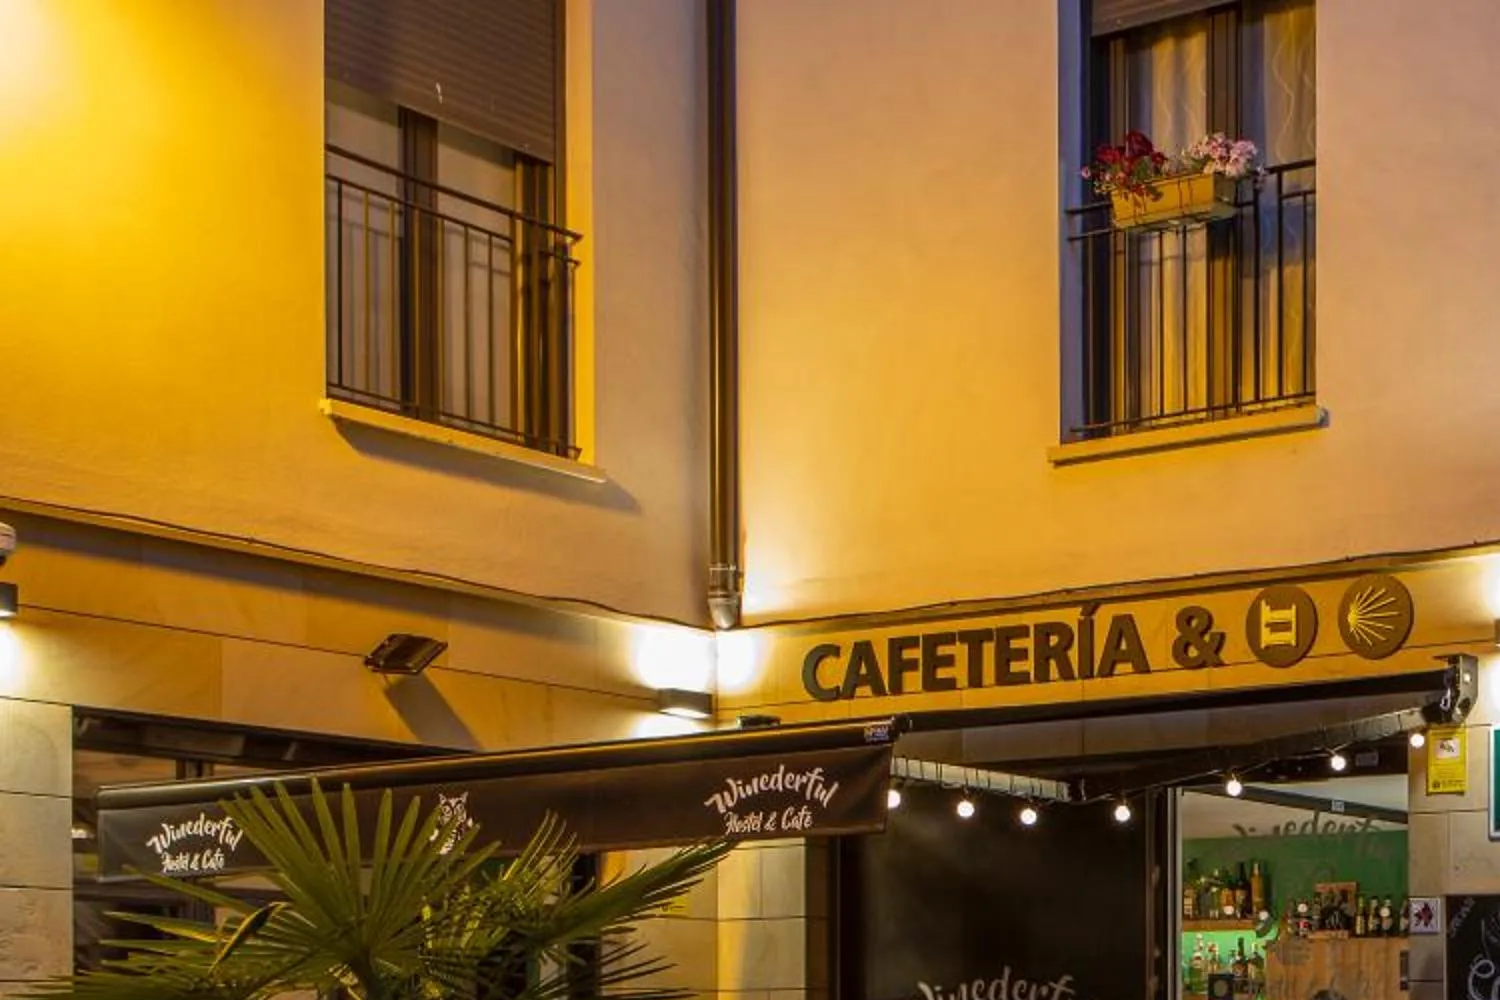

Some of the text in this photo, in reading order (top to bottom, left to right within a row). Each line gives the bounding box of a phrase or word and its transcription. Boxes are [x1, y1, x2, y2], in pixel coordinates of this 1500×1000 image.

[801, 602, 1226, 701] CAFETERÍA &
[704, 764, 840, 814] Winederful
[145, 811, 244, 854] Winederful
